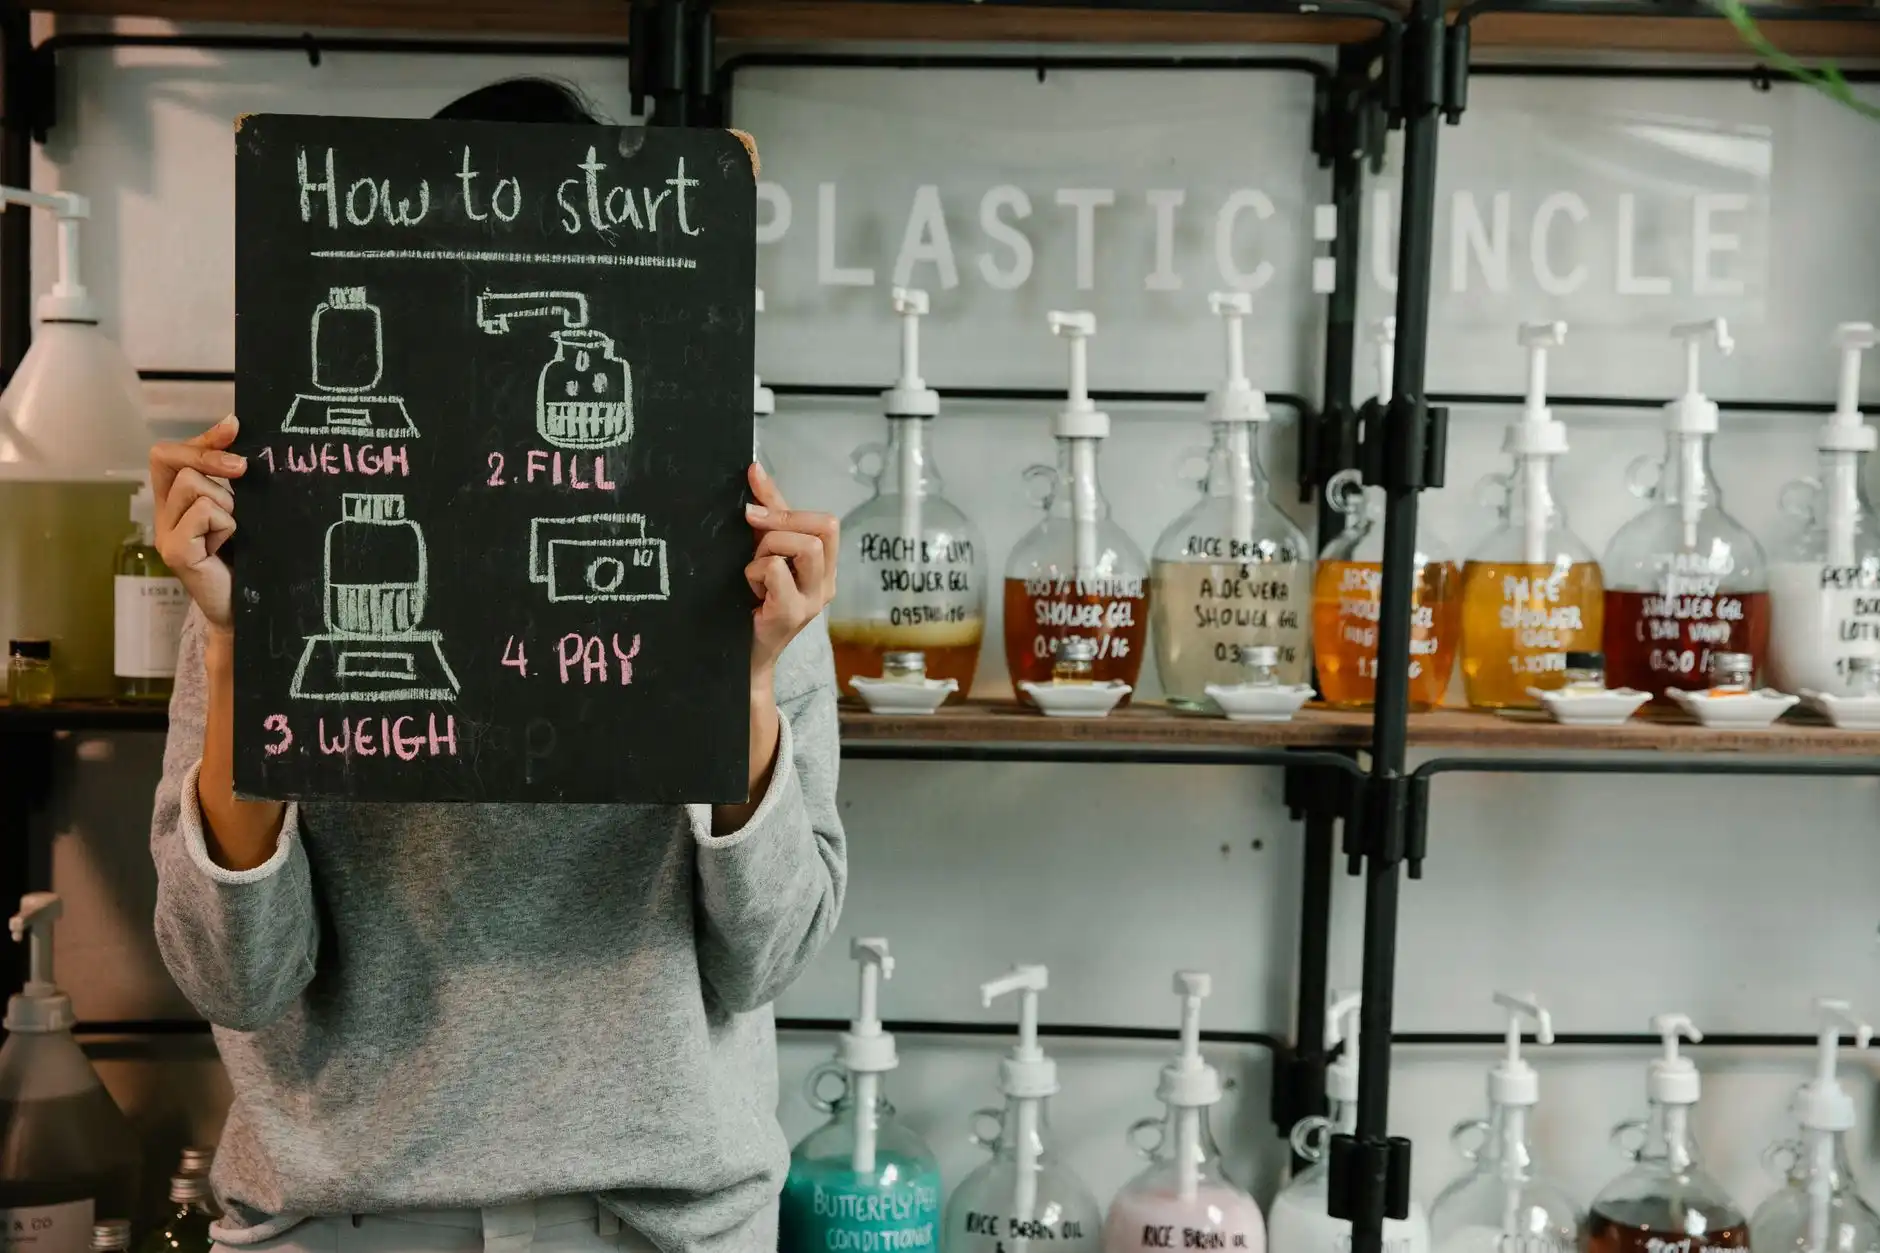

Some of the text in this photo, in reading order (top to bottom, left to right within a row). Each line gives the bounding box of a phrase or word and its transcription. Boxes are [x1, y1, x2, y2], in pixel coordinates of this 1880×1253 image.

[297, 147, 430, 229] How
[456, 145, 523, 222] to
[861, 532, 915, 563] PEACH
[1188, 536, 1222, 558] RICE
[881, 569, 968, 593] SHOWER GEL
[1248, 581, 1289, 601] VERA
[1034, 600, 1135, 628] SHOWER GEL
[558, 632, 642, 686] PAY
[319, 711, 458, 761] WEIGH
[813, 1183, 914, 1222] BUTTERFLY
[966, 1211, 999, 1237] RICE
[1009, 1217, 1055, 1240] BRAN
[1142, 1224, 1176, 1249] RICE
